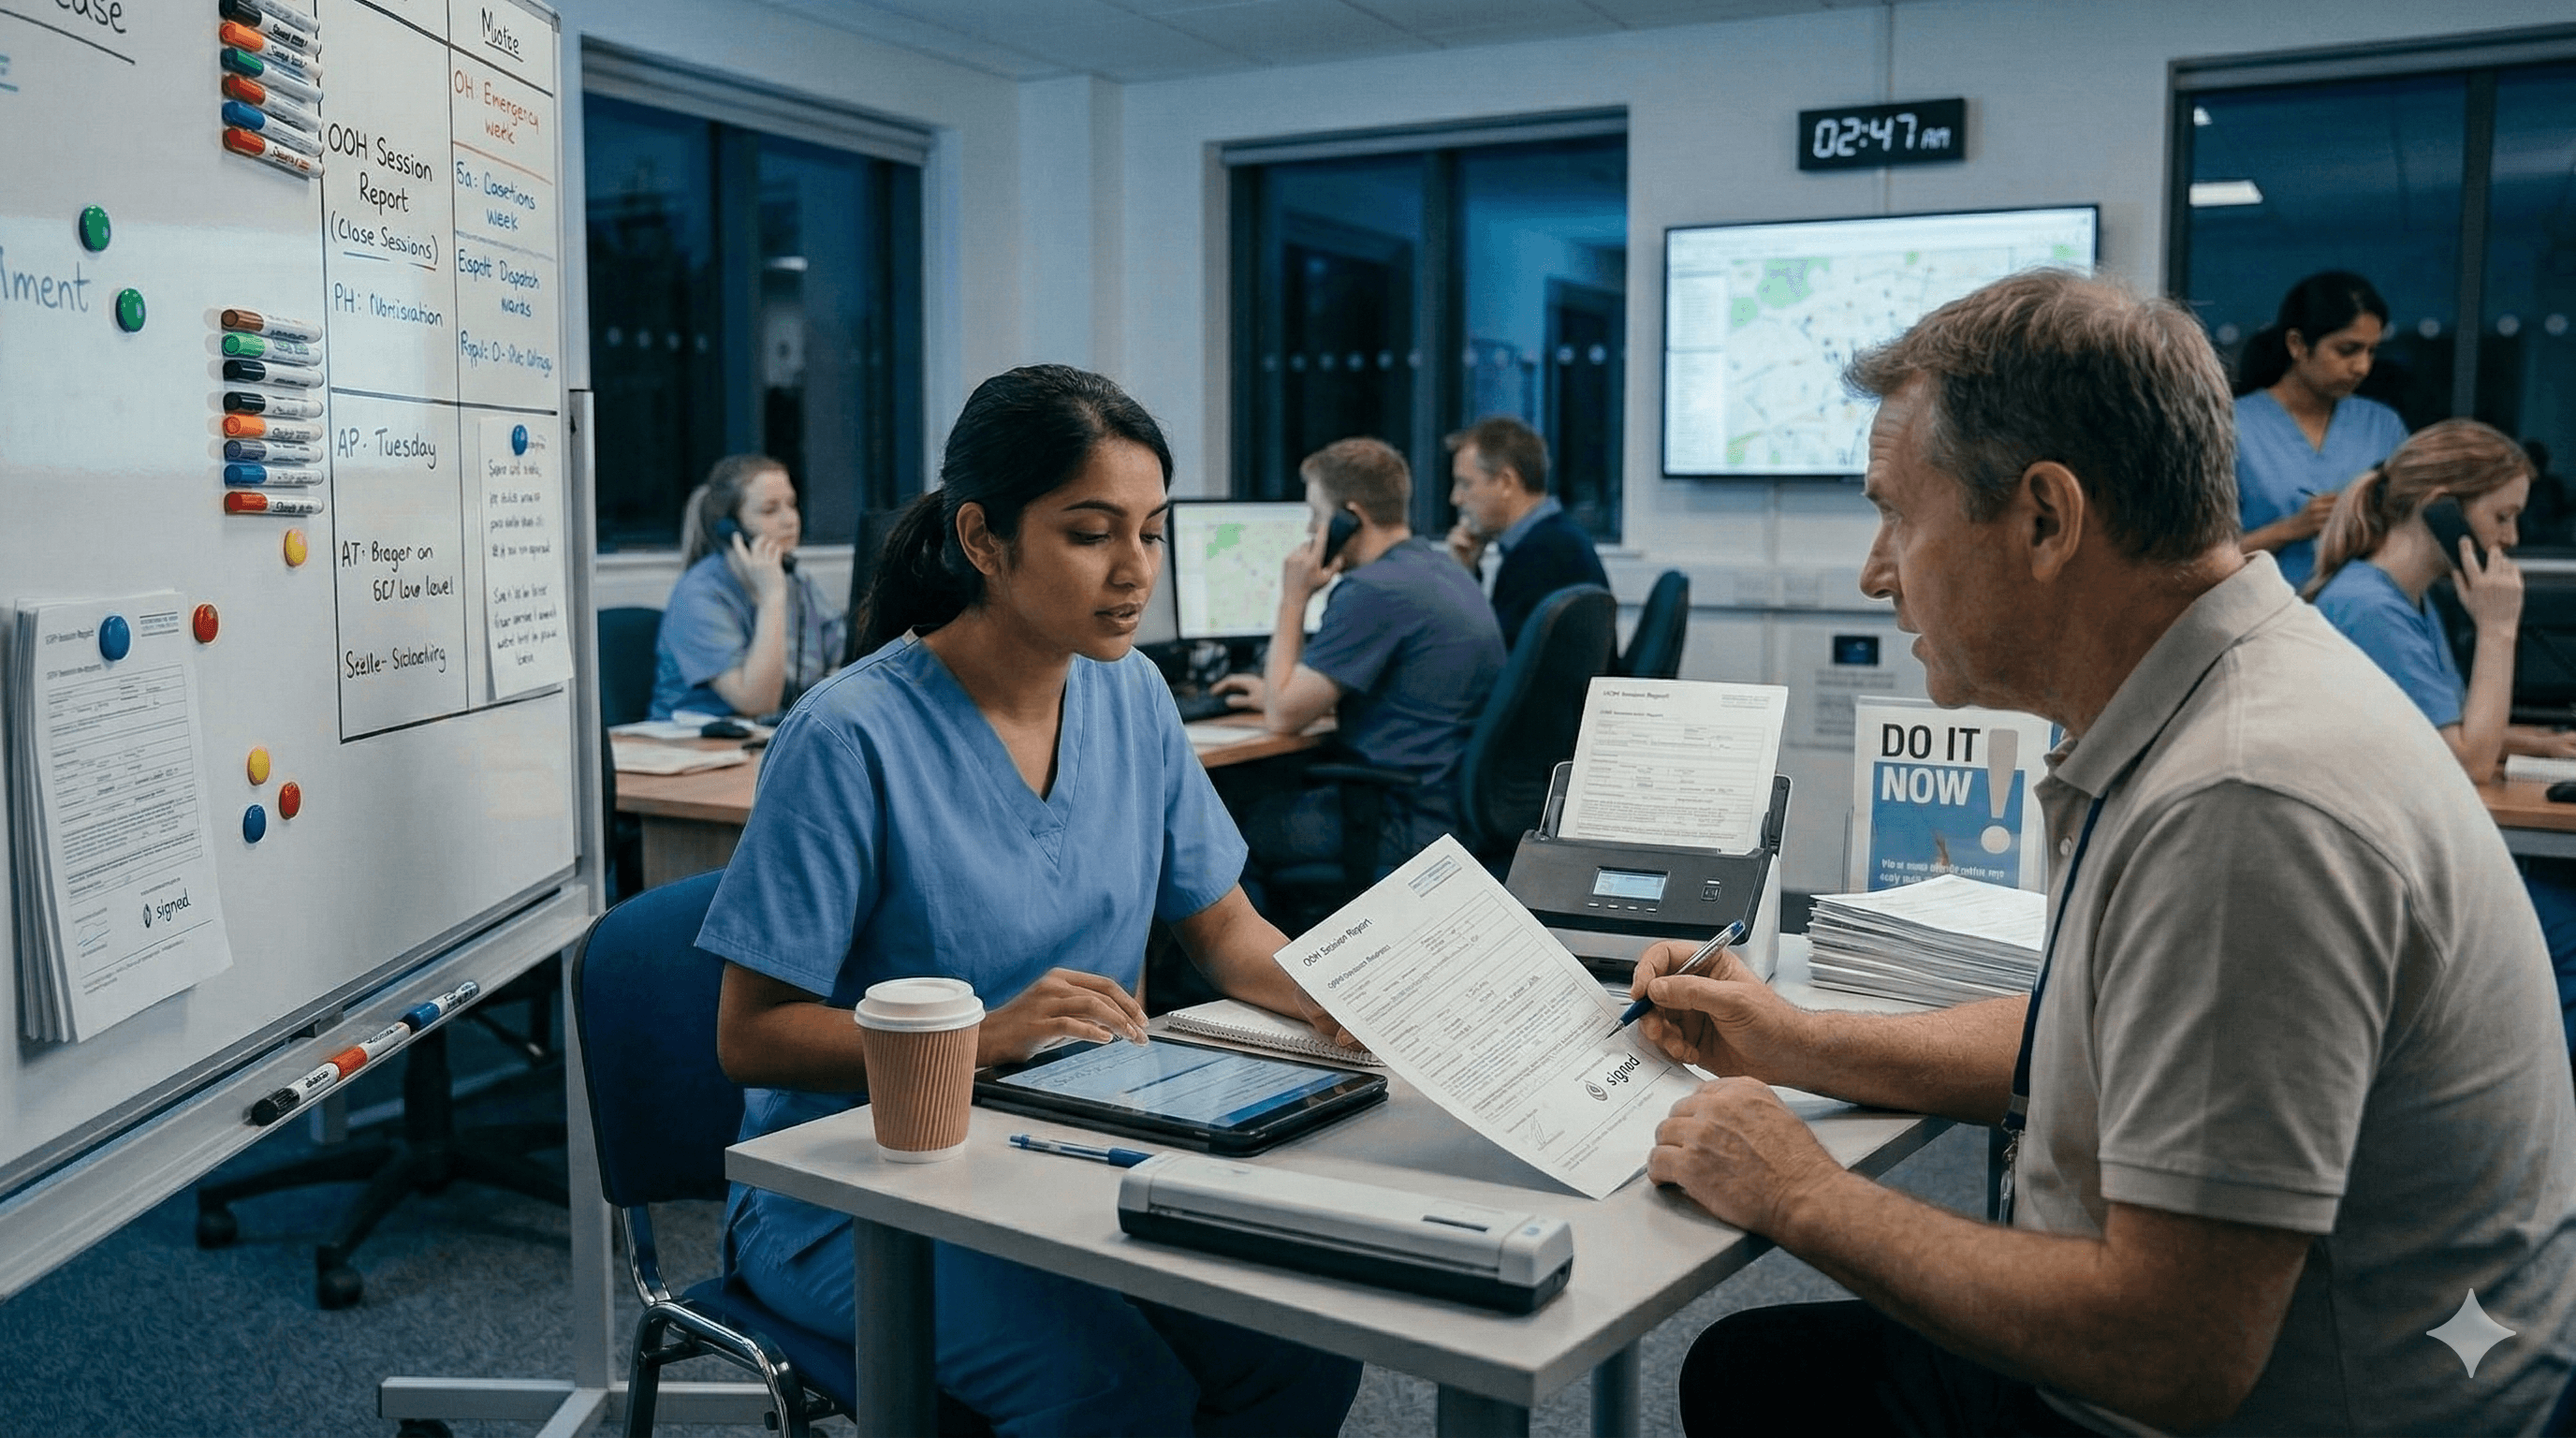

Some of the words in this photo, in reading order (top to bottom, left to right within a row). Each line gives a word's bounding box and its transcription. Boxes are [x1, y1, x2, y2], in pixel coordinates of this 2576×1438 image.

[329, 123, 367, 160] OOH
[377, 137, 432, 182] Session
[1813, 112, 1917, 159] 02:47
[1920, 126, 1952, 150] AM
[359, 171, 409, 215] Report
[330, 211, 374, 246] (Close
[380, 227, 439, 265] Sessions)
[334, 282, 361, 313] PH:
[375, 428, 437, 469] Tuesday
[426, 575, 453, 595] level
[1881, 724, 1932, 759] DO
[1947, 726, 1981, 762] IT
[1881, 766, 1973, 806] NOW
[156, 888, 191, 921] signed
